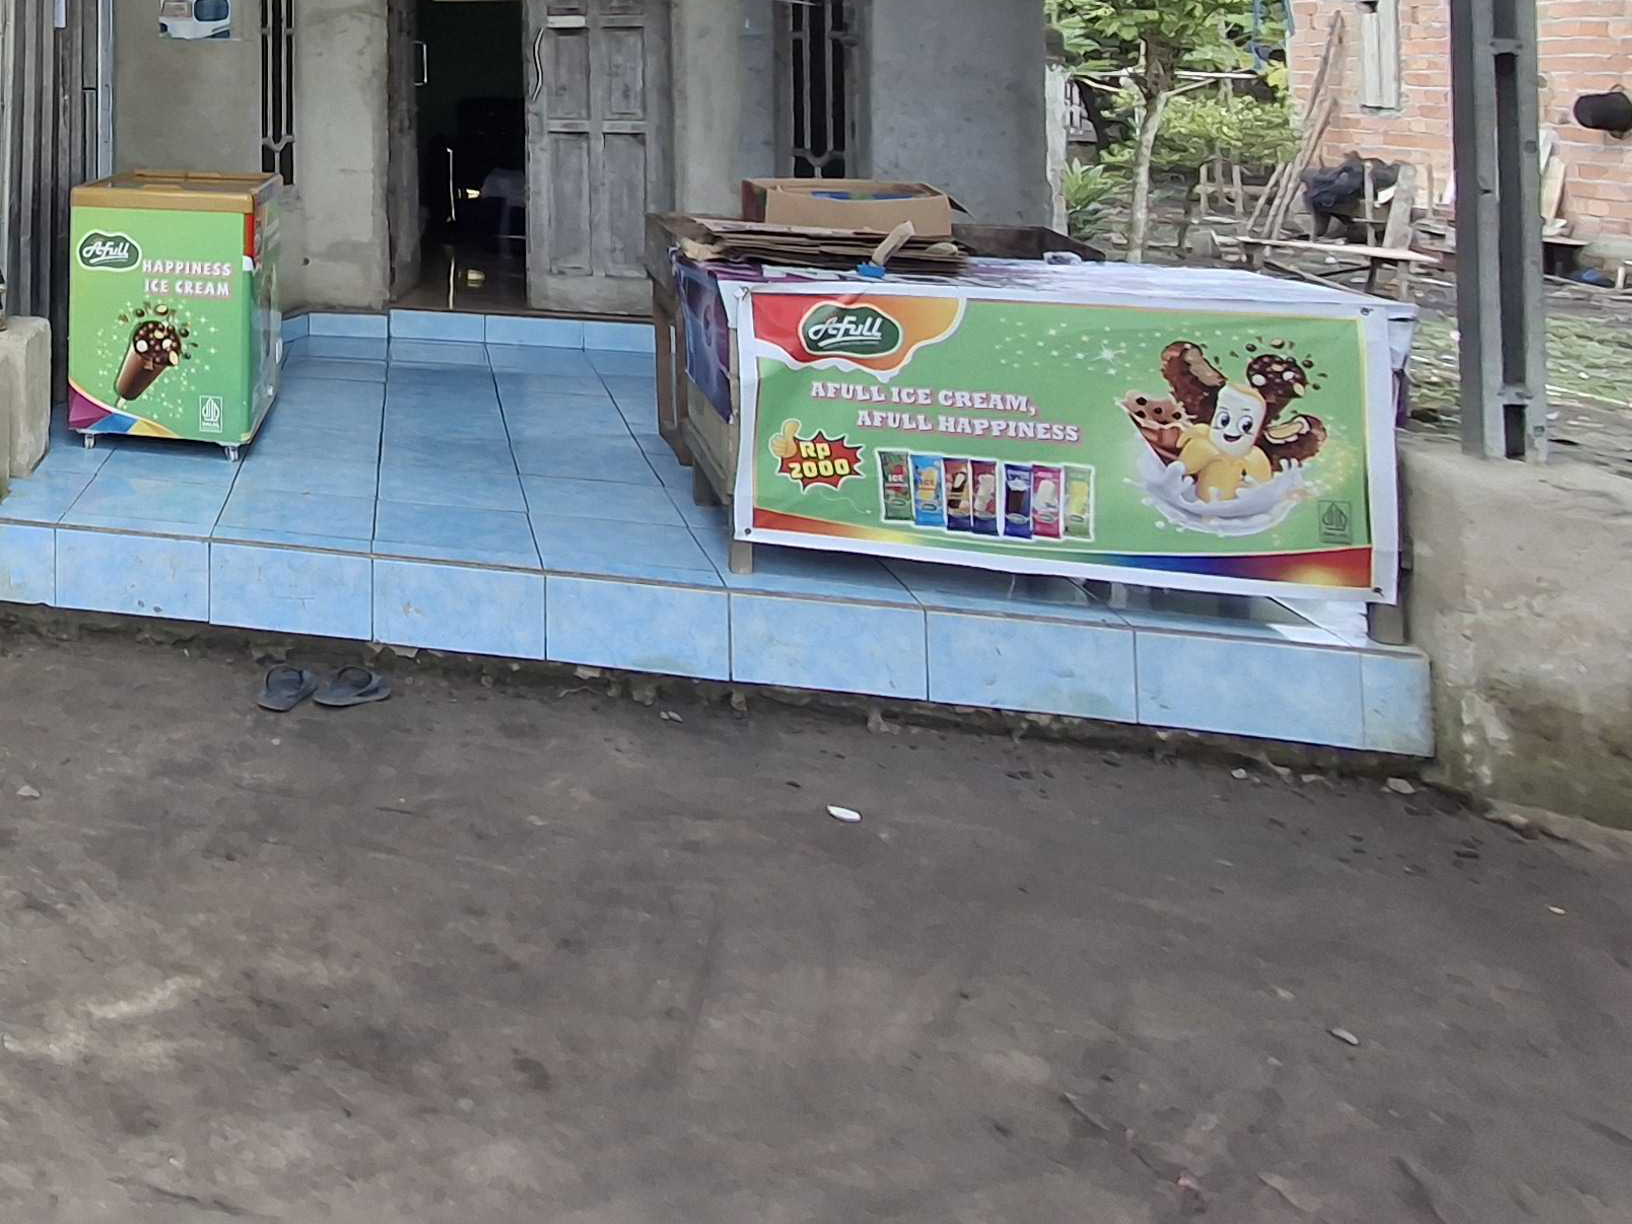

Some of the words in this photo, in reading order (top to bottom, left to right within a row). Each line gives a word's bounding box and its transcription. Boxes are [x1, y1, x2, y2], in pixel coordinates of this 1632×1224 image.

[142, 259, 232, 276] HAPPINESS
[144, 279, 170, 294] ICE
[175, 280, 230, 297] CREAM
[811, 380, 886, 403] AFULL
[891, 386, 932, 406] ICE
[938, 389, 1038, 417] CREAM,
[857, 409, 933, 432] AFULL
[937, 416, 1080, 442] HAPPINESS
[798, 440, 832, 460] Rp
[788, 457, 852, 478] 2000
